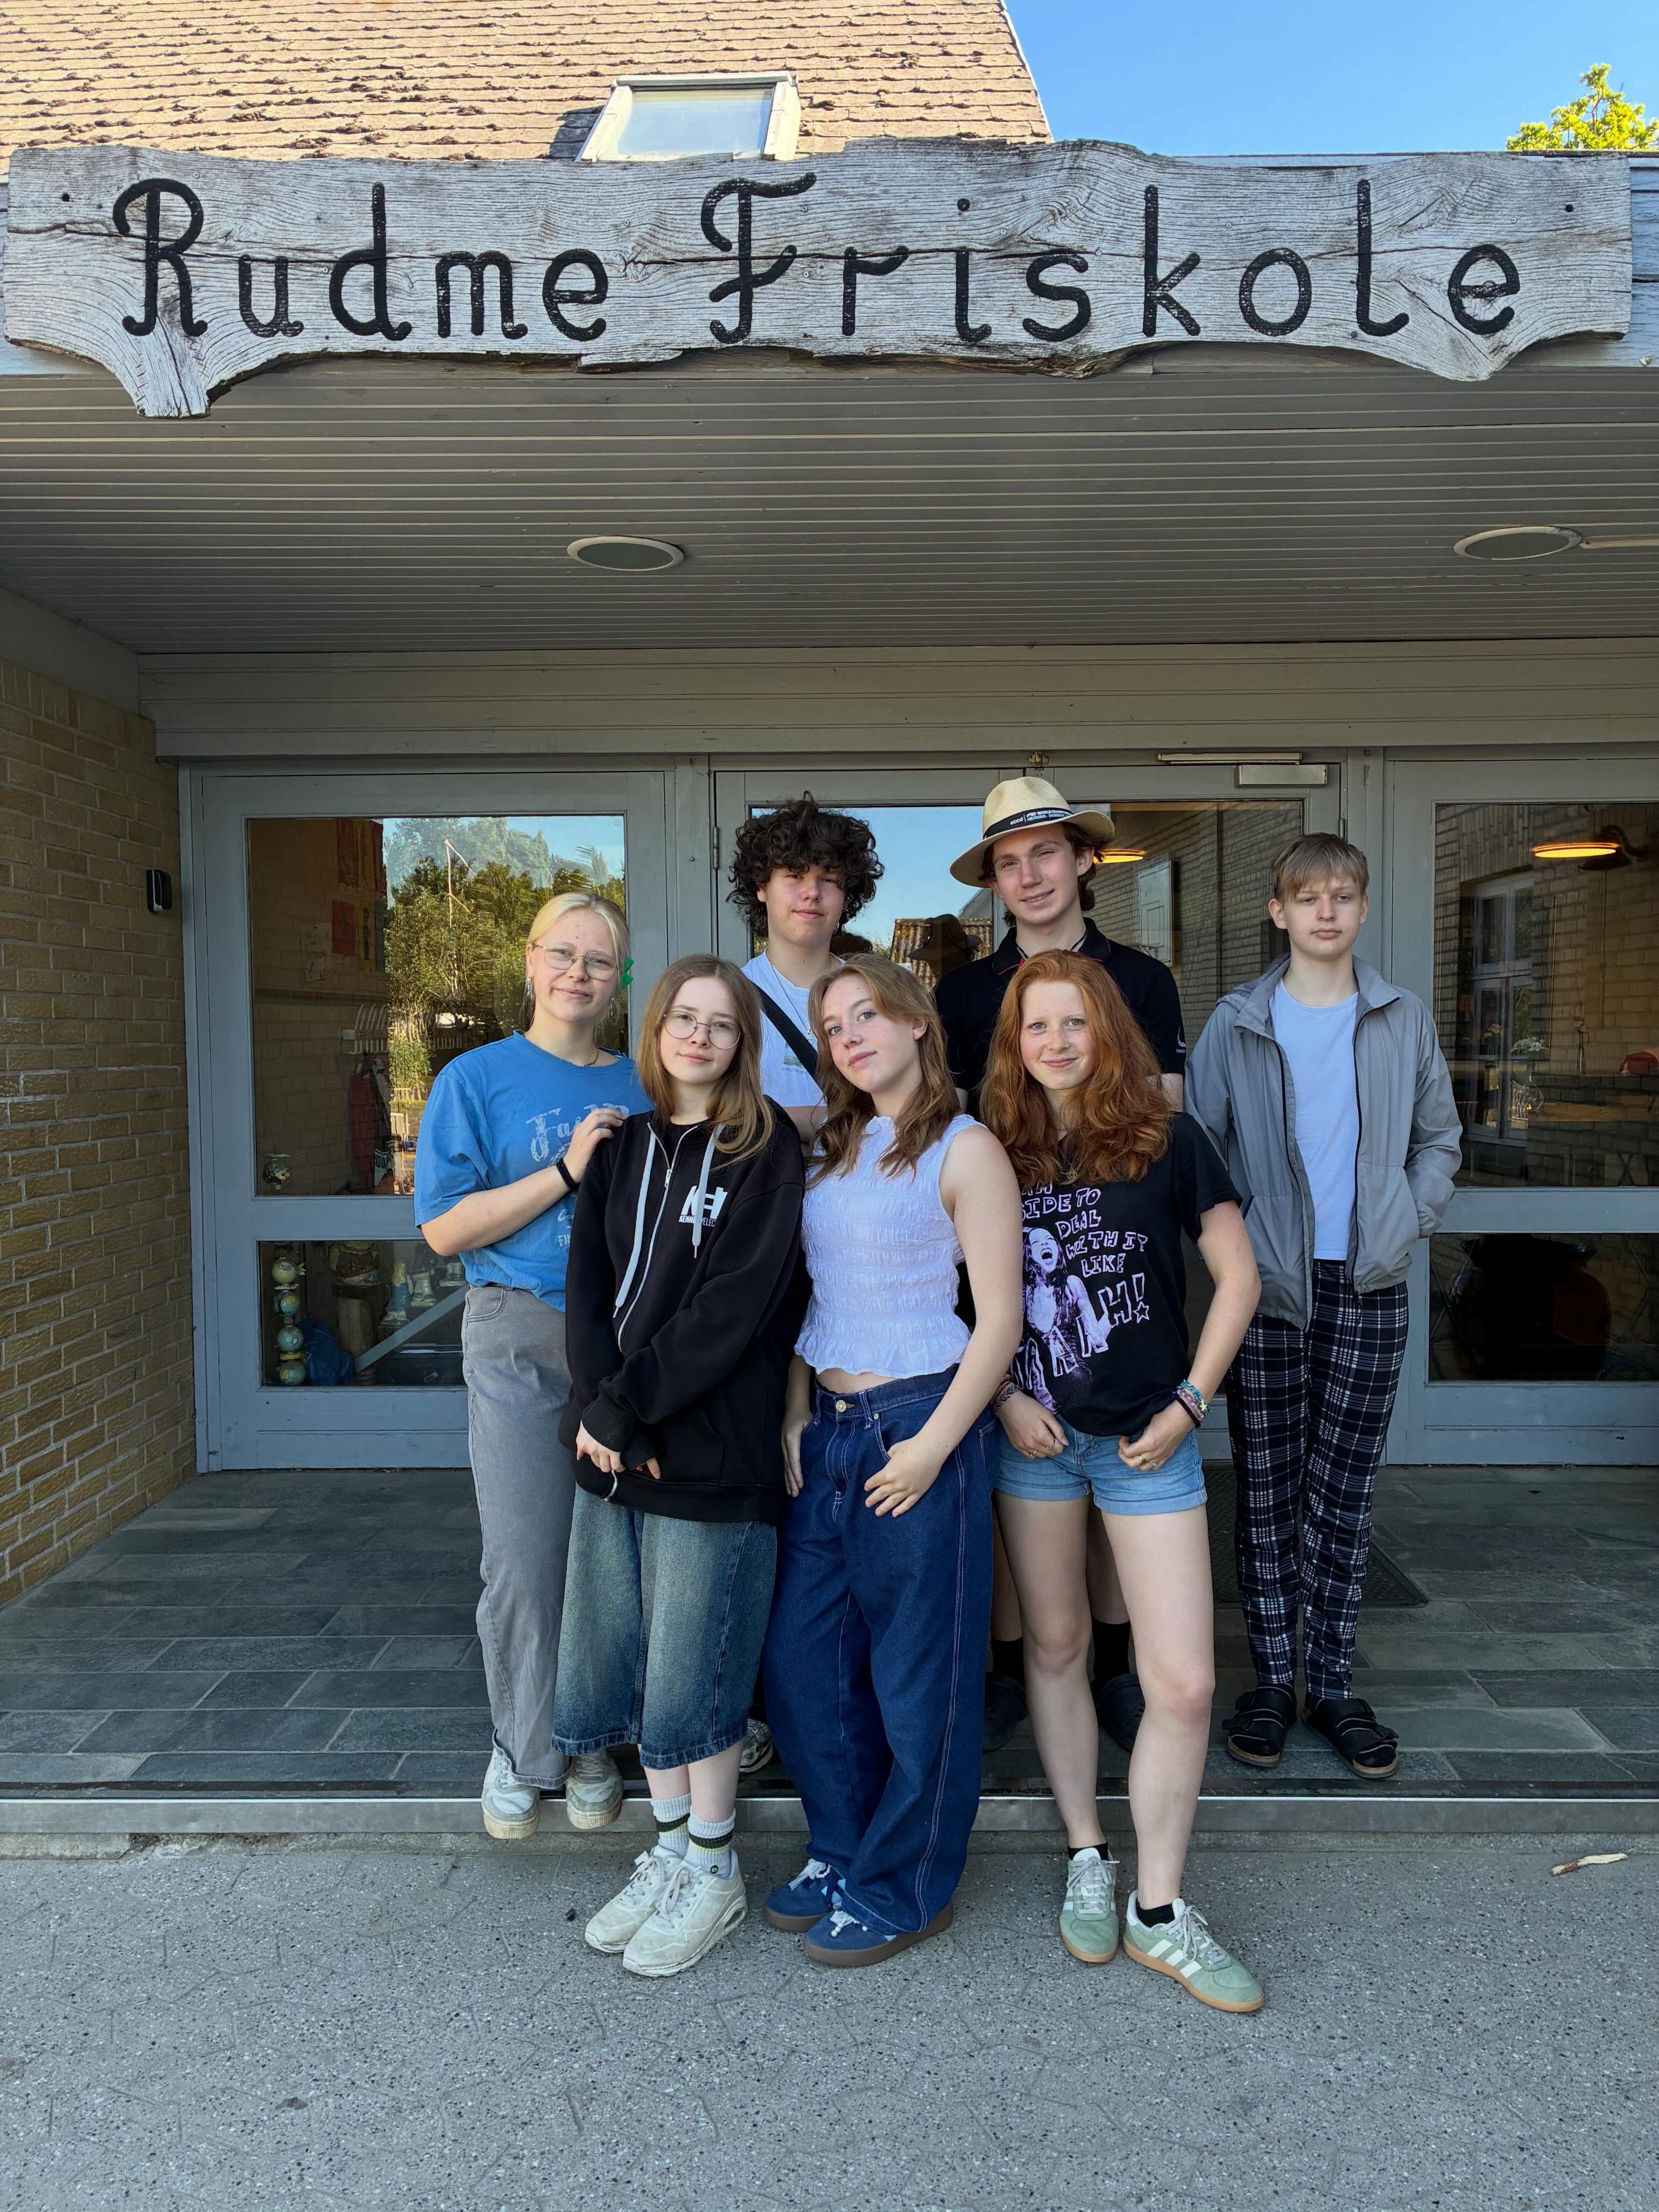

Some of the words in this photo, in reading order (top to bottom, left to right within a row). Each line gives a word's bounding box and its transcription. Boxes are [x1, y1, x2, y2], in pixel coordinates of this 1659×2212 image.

[112, 177, 608, 342] Rudme
[701, 172, 1521, 344] Friskole
[1010, 816, 1023, 825] ecco
[1076, 1188, 1101, 1208] TO
[1055, 1209, 1102, 1240] DEAL
[1065, 1231, 1119, 1260] WITH
[1122, 1231, 1148, 1252] IT
[1081, 1253, 1126, 1278] LIKE
